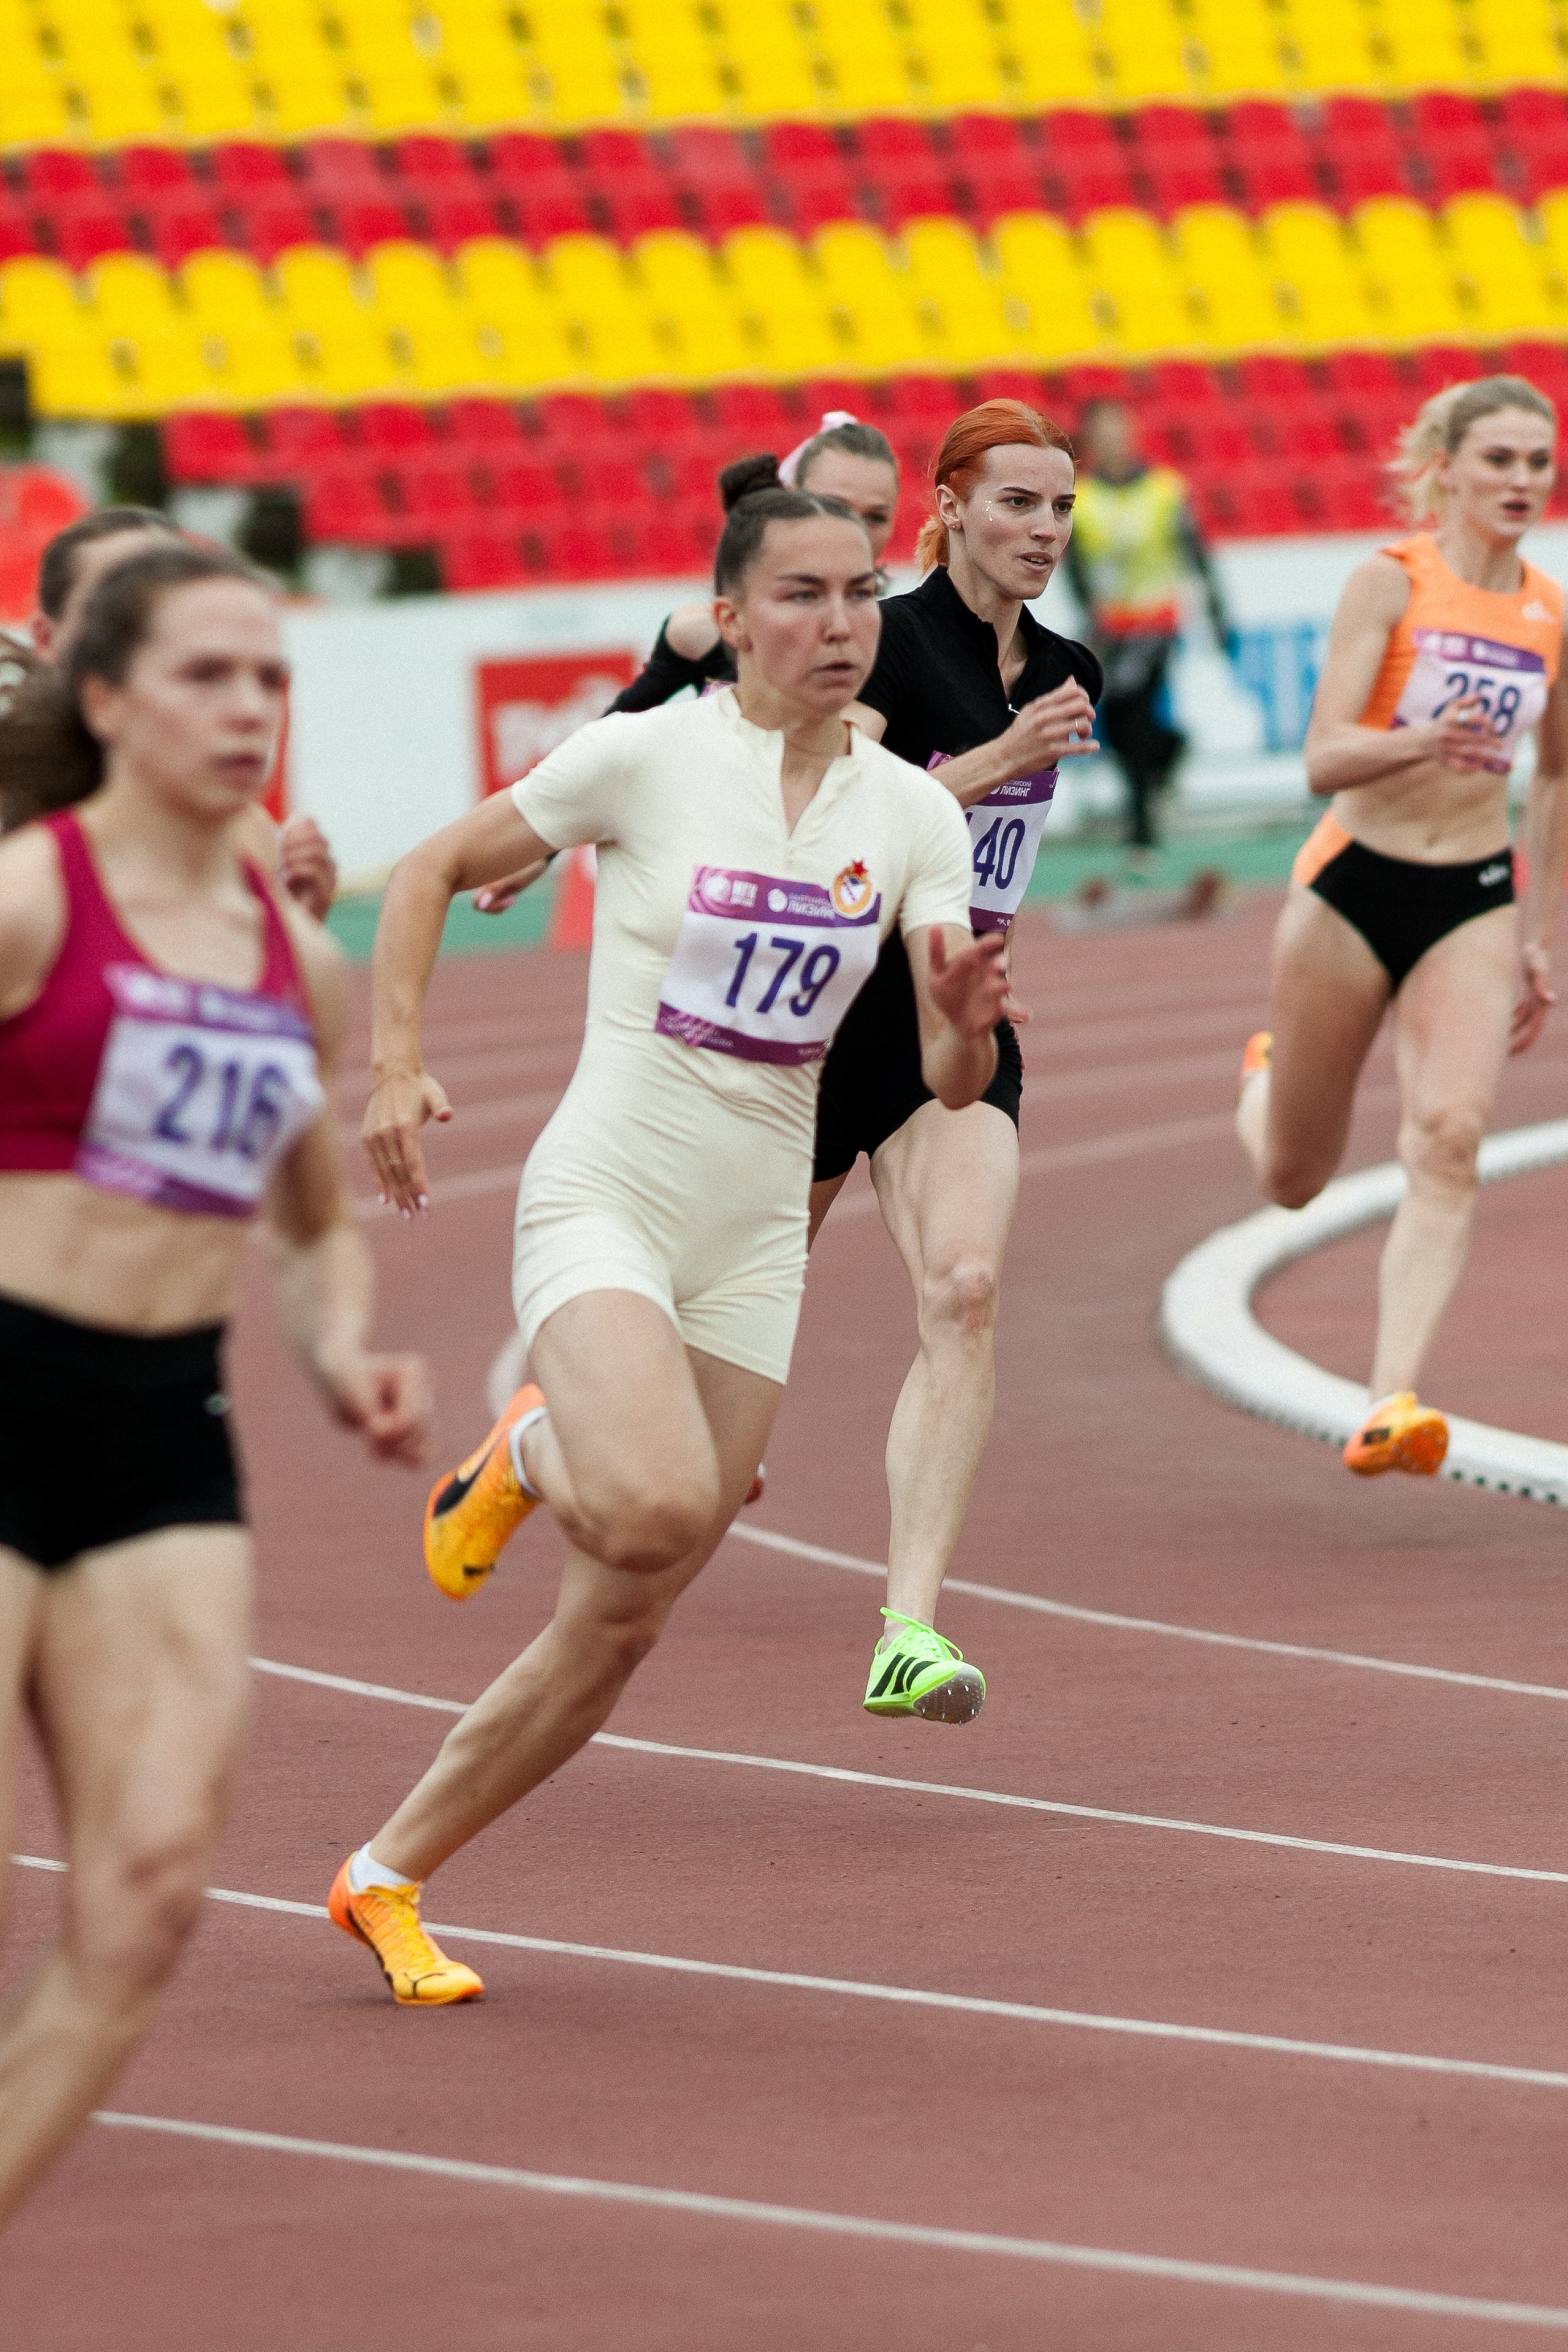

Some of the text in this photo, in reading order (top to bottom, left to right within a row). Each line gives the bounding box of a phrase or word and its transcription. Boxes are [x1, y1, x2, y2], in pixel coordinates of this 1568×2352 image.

[1430, 672, 1521, 736] 258
[999, 785, 1031, 798] ЛИЗИНГ
[965, 811, 1026, 890] 40
[724, 931, 841, 1017] 179
[153, 1042, 289, 1161] 216
